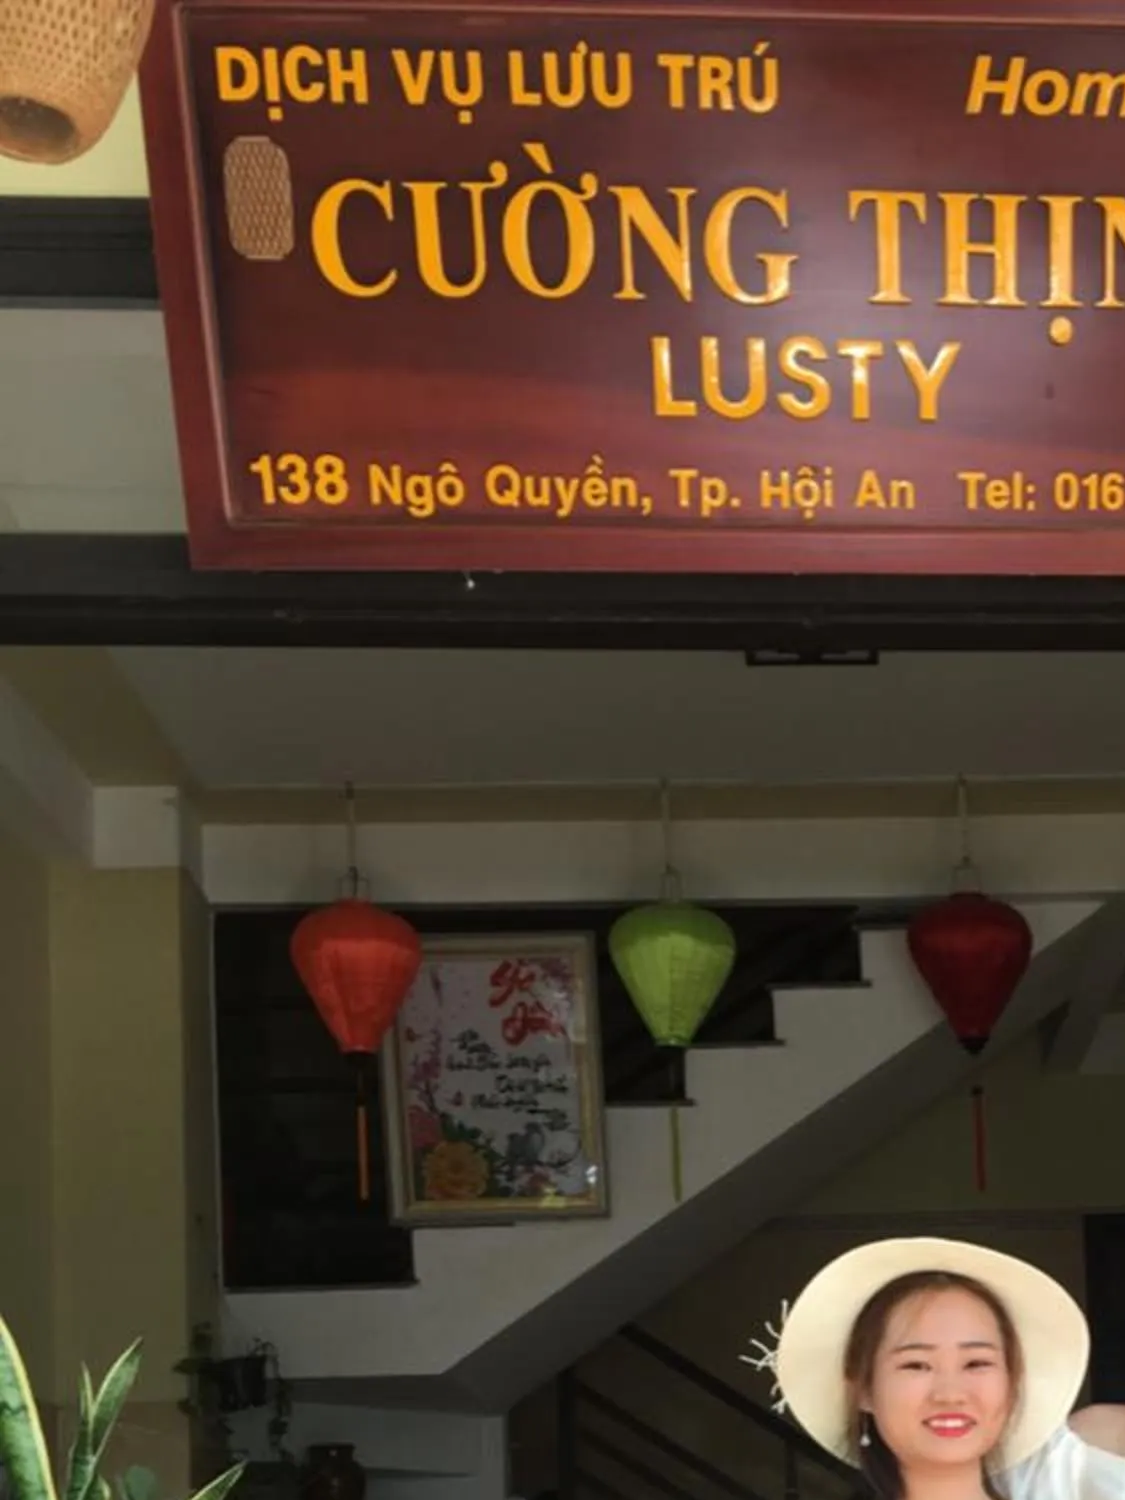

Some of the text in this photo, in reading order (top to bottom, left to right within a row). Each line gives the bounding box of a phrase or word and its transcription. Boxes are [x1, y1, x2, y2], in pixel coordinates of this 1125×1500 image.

[216, 41, 780, 124] DỊCH VỤ LƯU TRÚ
[310, 142, 800, 305] CƯỜNG
[649, 332, 962, 422] LUSTY
[249, 453, 916, 520] 138 Ngô Quyền, Tp. Hội An
[957, 471, 1037, 513] Tel:
